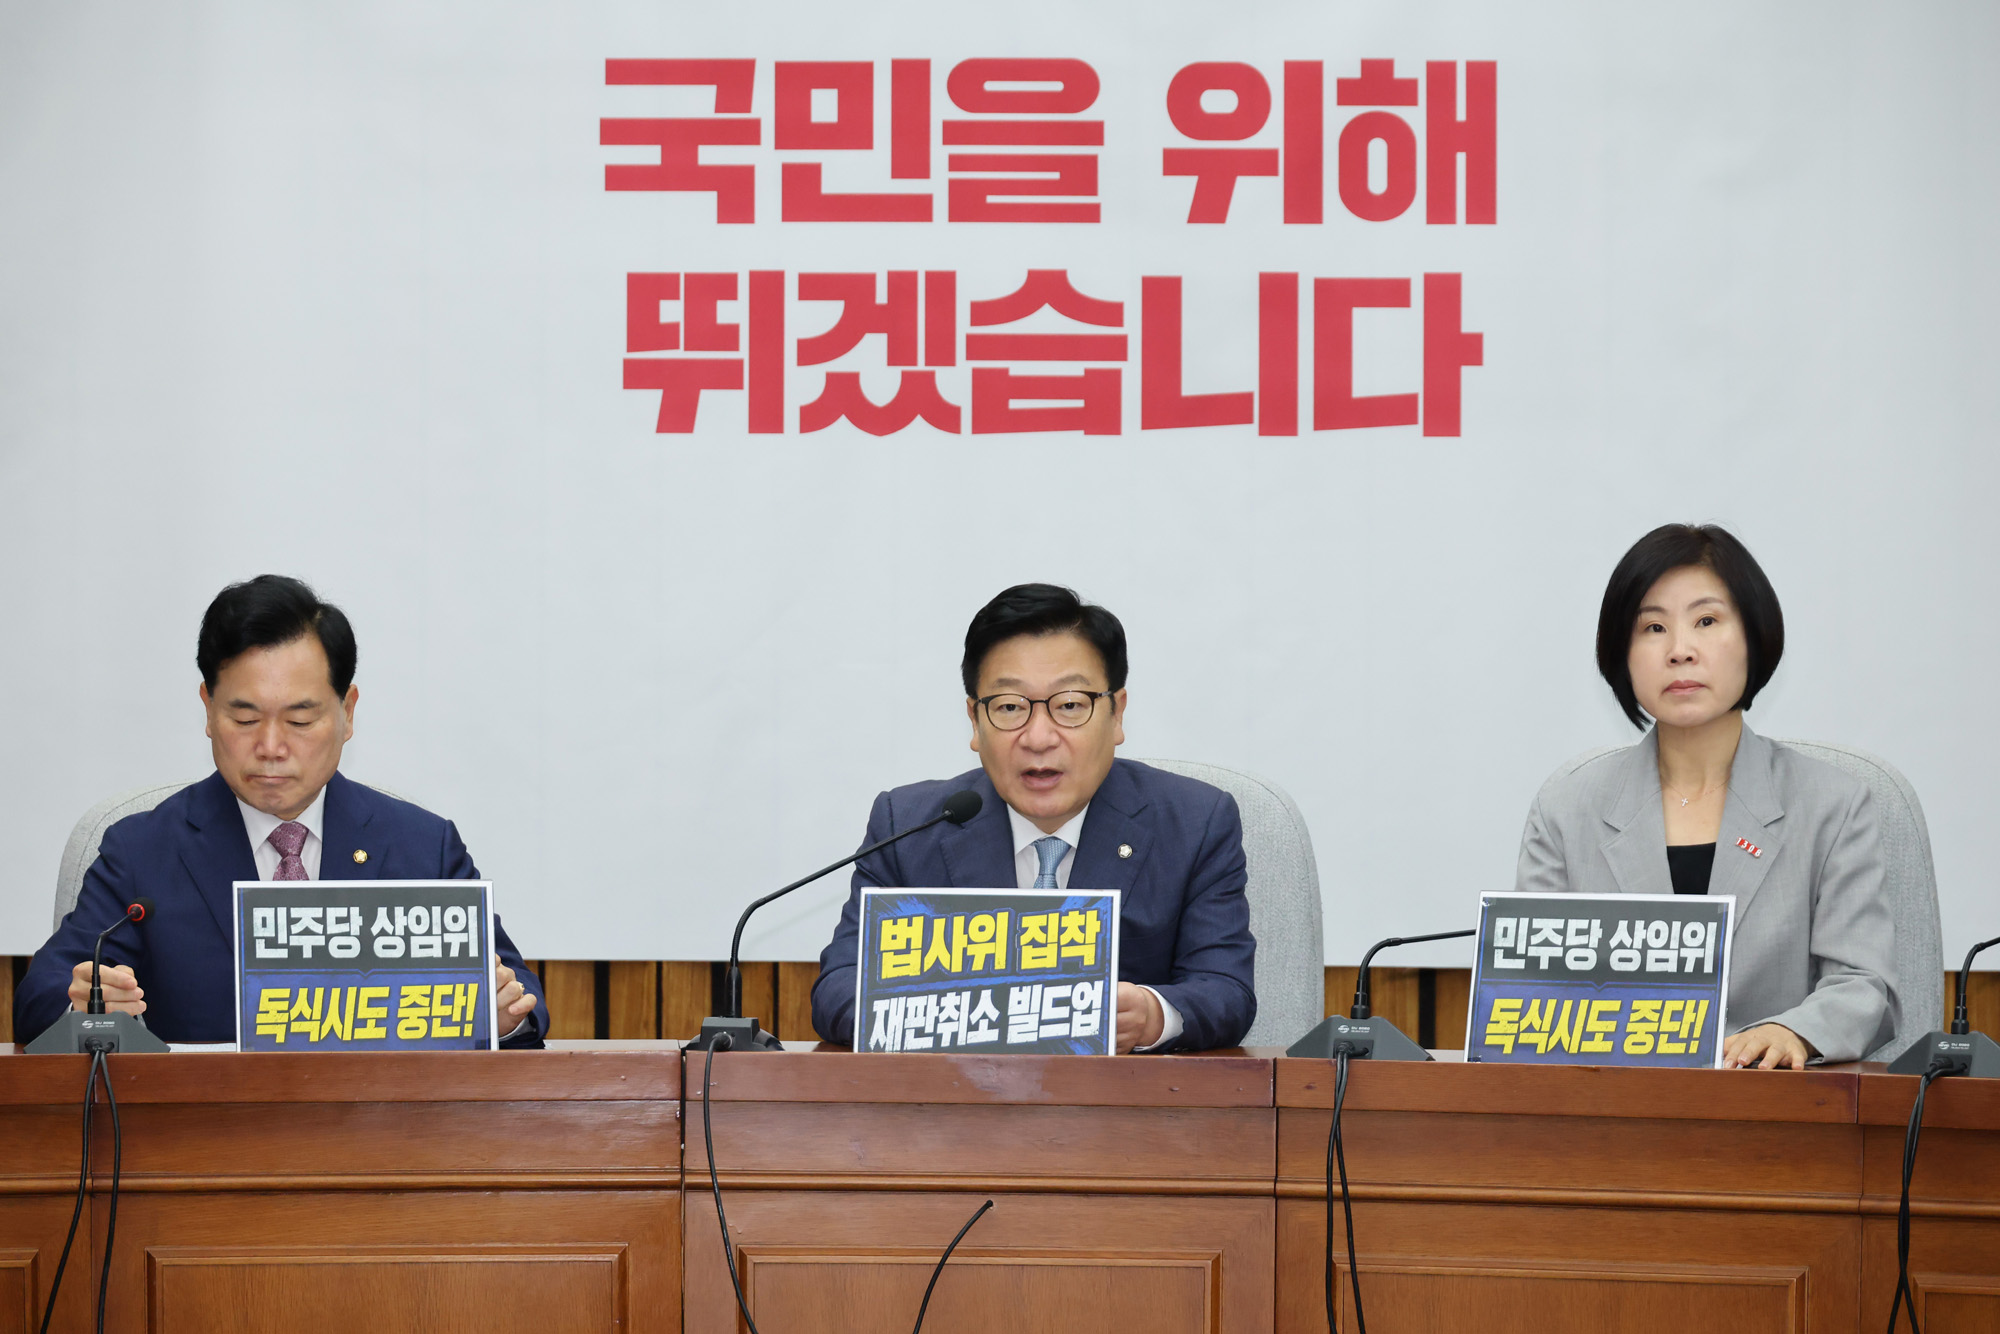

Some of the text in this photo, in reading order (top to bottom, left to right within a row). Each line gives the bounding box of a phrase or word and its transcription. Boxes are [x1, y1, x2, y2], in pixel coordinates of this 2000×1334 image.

[600, 58, 1498, 225] 국민을 위해
[623, 269, 1484, 437] 뛰겠습니다
[1736, 837, 1762, 858] 1308
[252, 905, 479, 959] 민주당 상임위
[880, 909, 1101, 980] 법사위 집착
[1493, 917, 1718, 974] 민주당 상임위
[255, 983, 479, 1043] 독식시도 중단!
[868, 980, 1104, 1053] 재판취소 빌드업
[1484, 998, 1710, 1055] 독식시도 중단!
